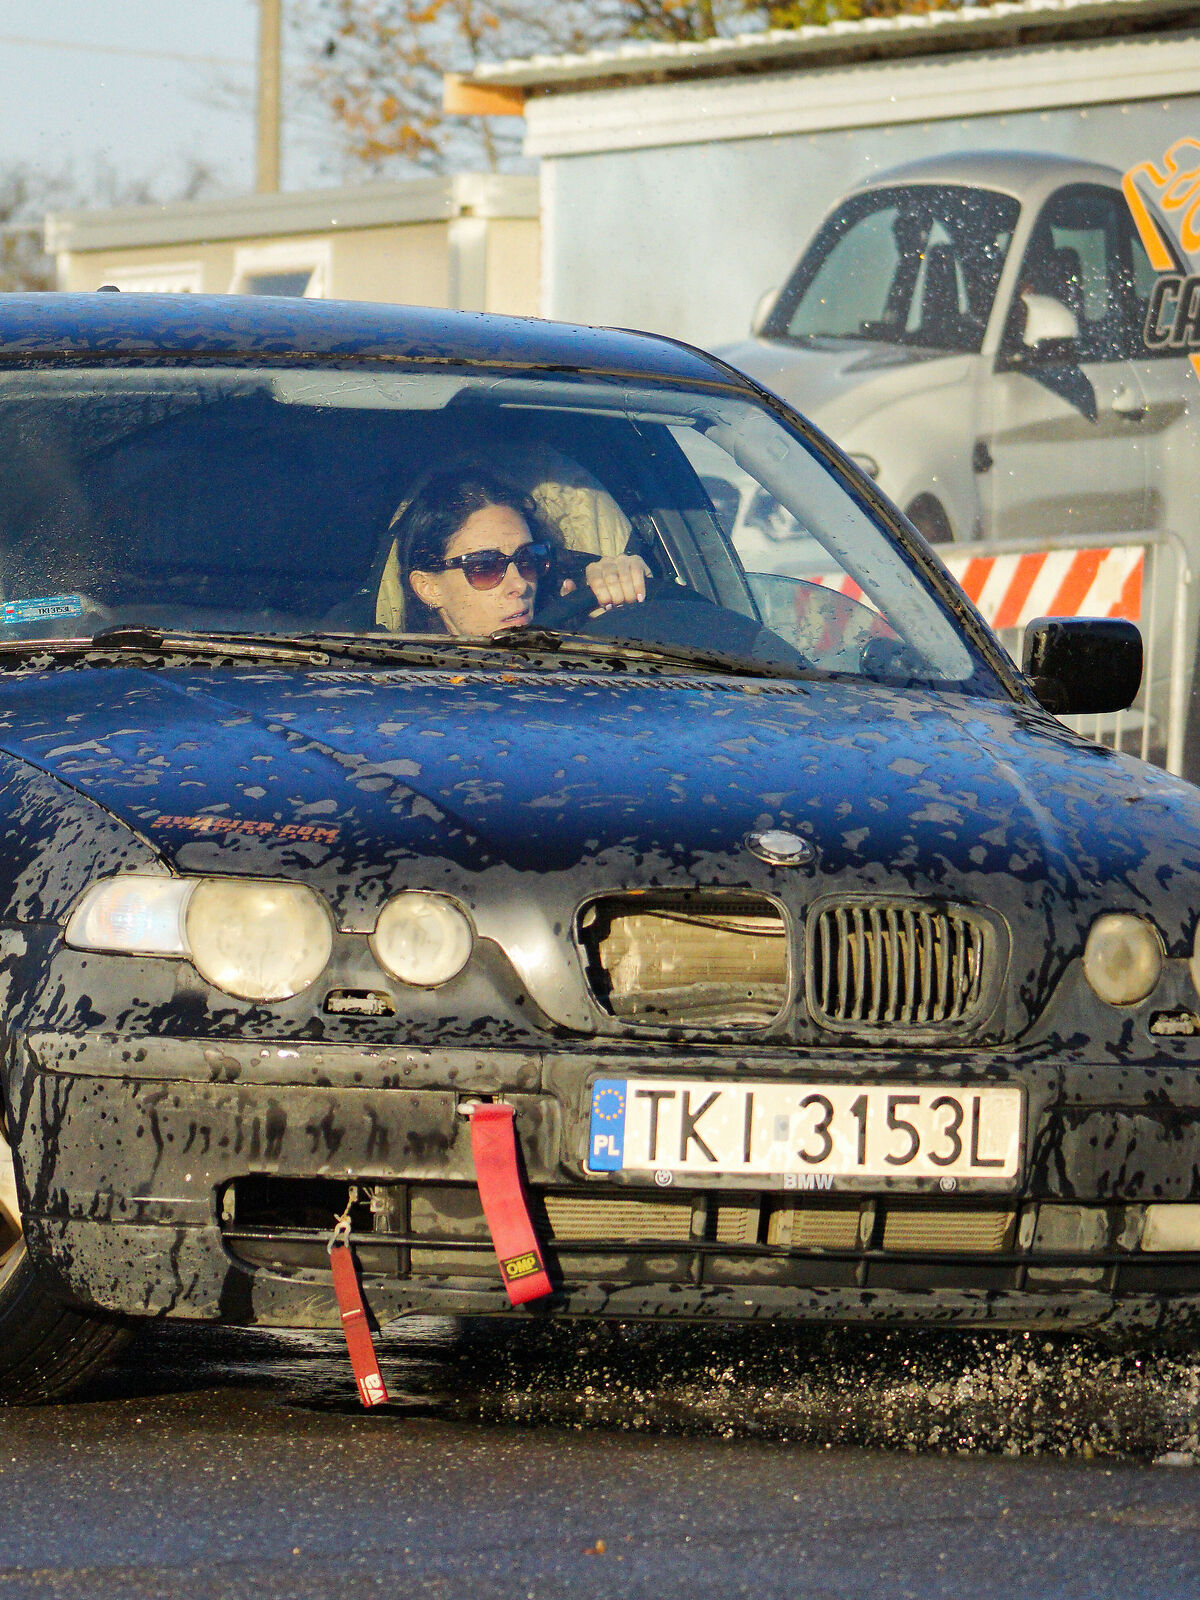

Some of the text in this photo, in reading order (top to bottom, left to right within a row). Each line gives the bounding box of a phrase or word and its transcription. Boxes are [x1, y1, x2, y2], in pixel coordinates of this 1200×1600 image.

[635, 1089, 1006, 1168] TKI 3153L
[593, 1134, 620, 1157] PL
[783, 1173, 835, 1190] BMW
[506, 1256, 536, 1275] OMP
